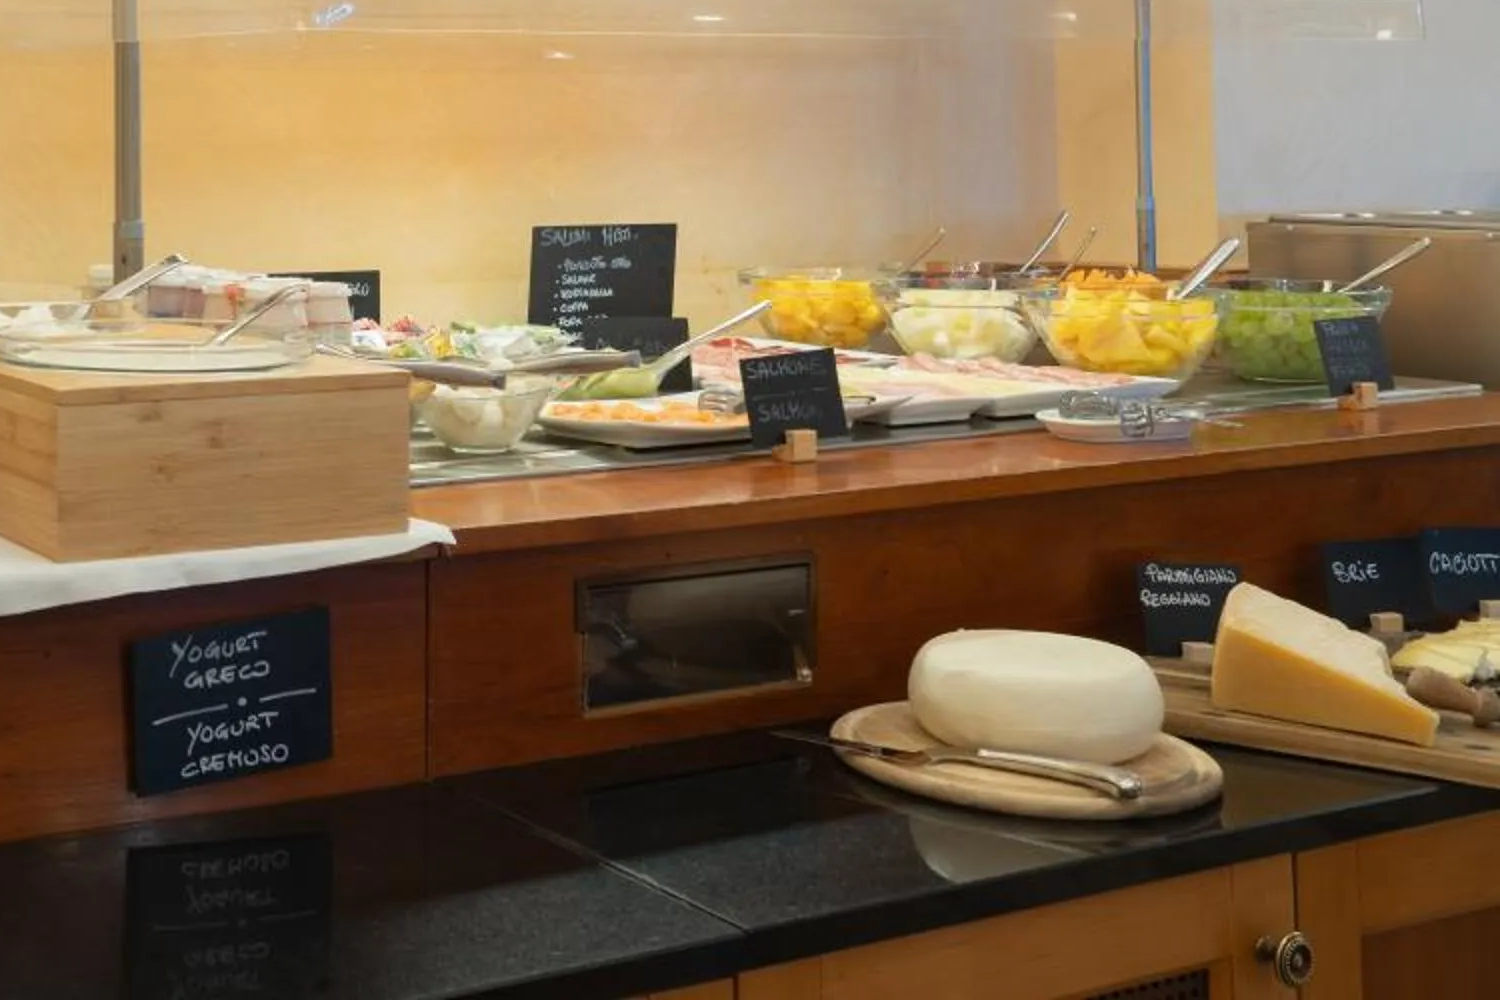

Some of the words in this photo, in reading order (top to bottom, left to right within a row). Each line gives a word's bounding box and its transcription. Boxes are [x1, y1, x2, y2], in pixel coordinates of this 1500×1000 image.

[169, 630, 267, 678] YOGURT
[184, 660, 270, 688] GRECO
[187, 711, 279, 756] YOGURT
[180, 744, 288, 777] CREMOSO
